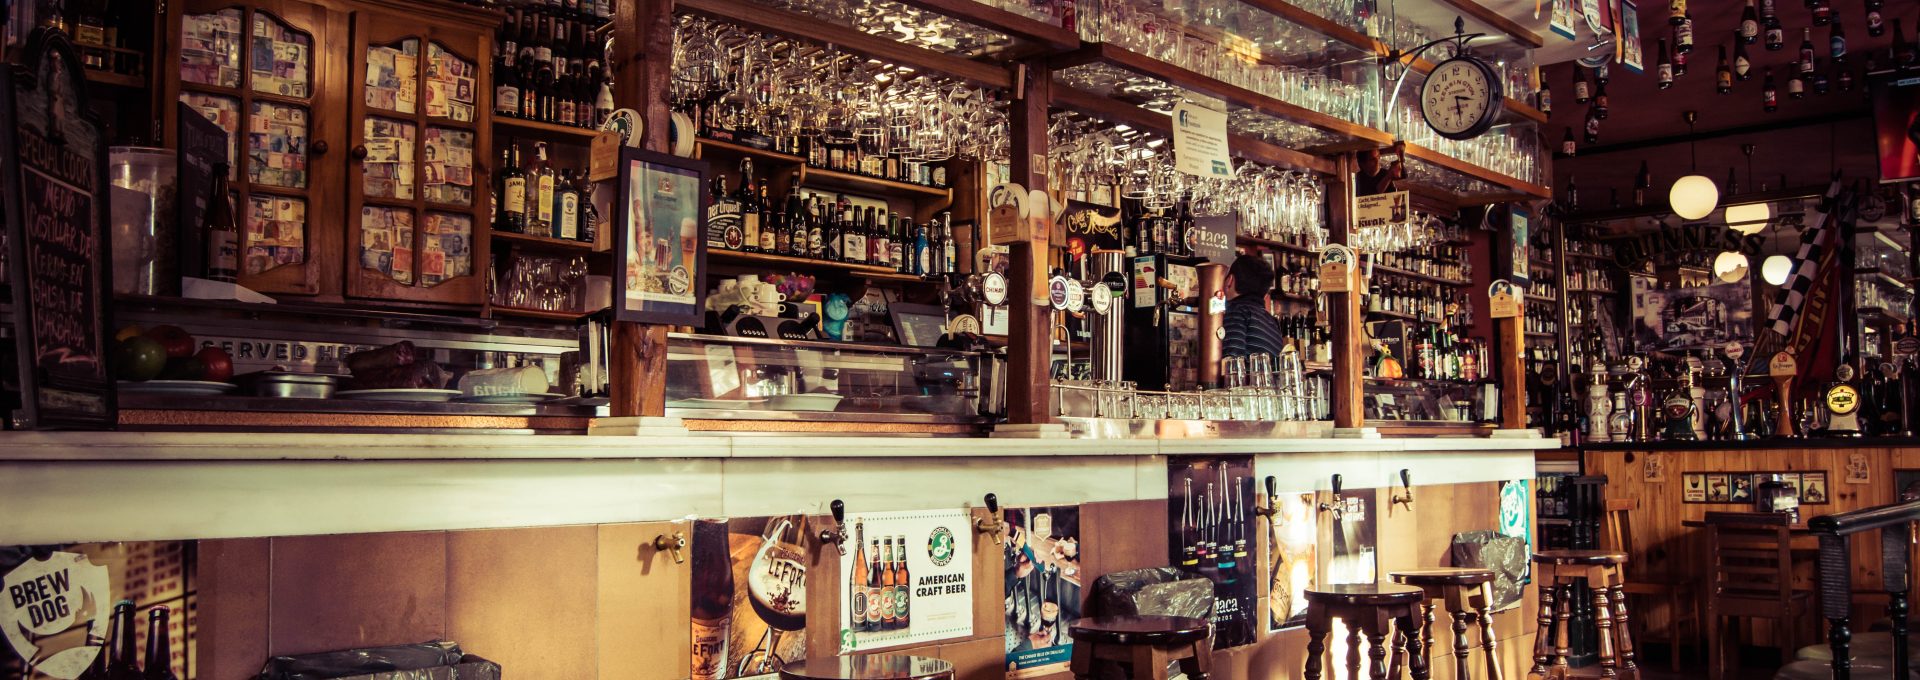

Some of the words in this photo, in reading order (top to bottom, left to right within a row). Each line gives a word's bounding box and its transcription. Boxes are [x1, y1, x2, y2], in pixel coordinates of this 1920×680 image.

[1440, 79, 1475, 102] KENSINGTON
[1615, 221, 1766, 269] GUINNESS
[9, 568, 70, 609] BREW
[916, 586, 942, 598] CRAFT
[946, 584, 966, 594] BEER
[918, 573, 964, 586] AMERICAN
[28, 596, 70, 628] DOG
